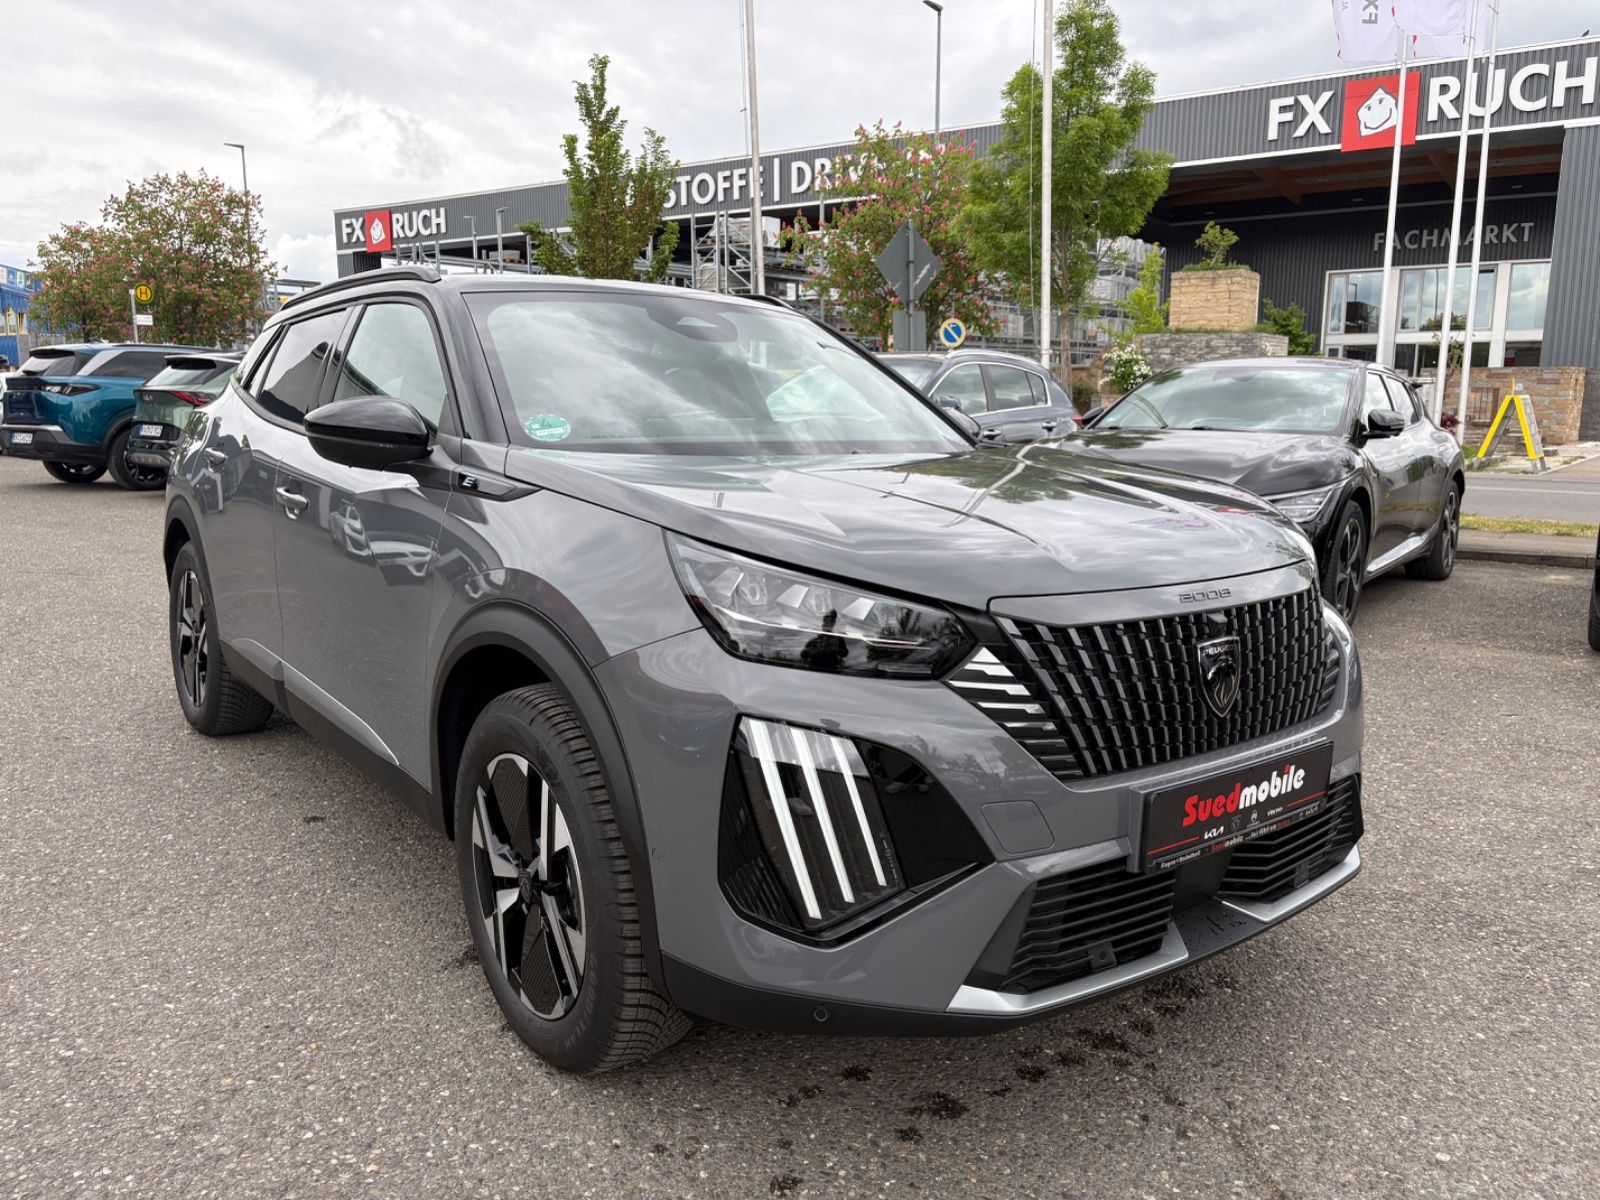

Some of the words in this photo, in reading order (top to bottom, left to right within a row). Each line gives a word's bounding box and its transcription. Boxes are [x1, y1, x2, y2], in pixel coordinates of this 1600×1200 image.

[1267, 90, 1334, 141] FX
[1427, 56, 1599, 122] RUCH
[341, 217, 366, 243] FX
[391, 207, 447, 239] RUCH
[1179, 588, 1231, 603] 2008
[1182, 763, 1306, 827] Suedmobile
